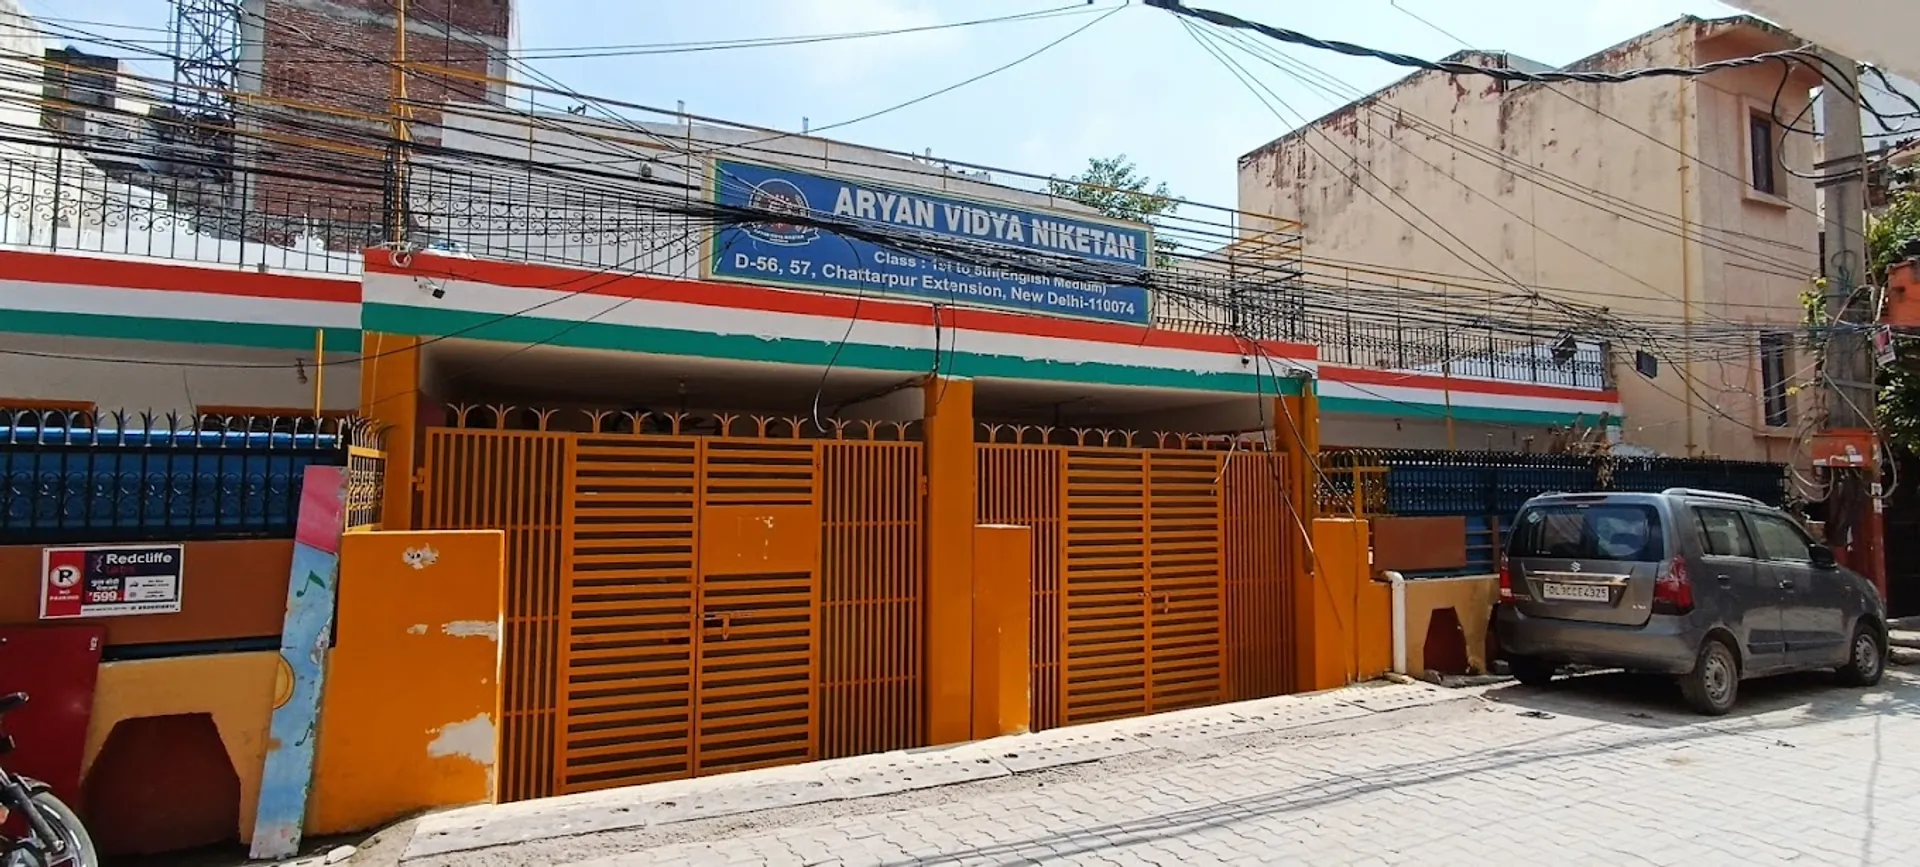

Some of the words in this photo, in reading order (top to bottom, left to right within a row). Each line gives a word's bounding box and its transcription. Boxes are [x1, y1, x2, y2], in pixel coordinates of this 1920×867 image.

[833, 186, 935, 229] ARYAN
[944, 203, 1024, 243] VIDYA
[1032, 218, 1135, 260] NIKETAN
[874, 251, 916, 268] Class
[735, 253, 783, 275] D-56,
[789, 260, 816, 279] 57,
[822, 263, 917, 287] Chattarpur
[922, 275, 1007, 301] Extension,
[1011, 286, 1044, 305] New
[1047, 290, 1135, 315] Delhi-110074
[106, 552, 173, 565] Redcliffe
